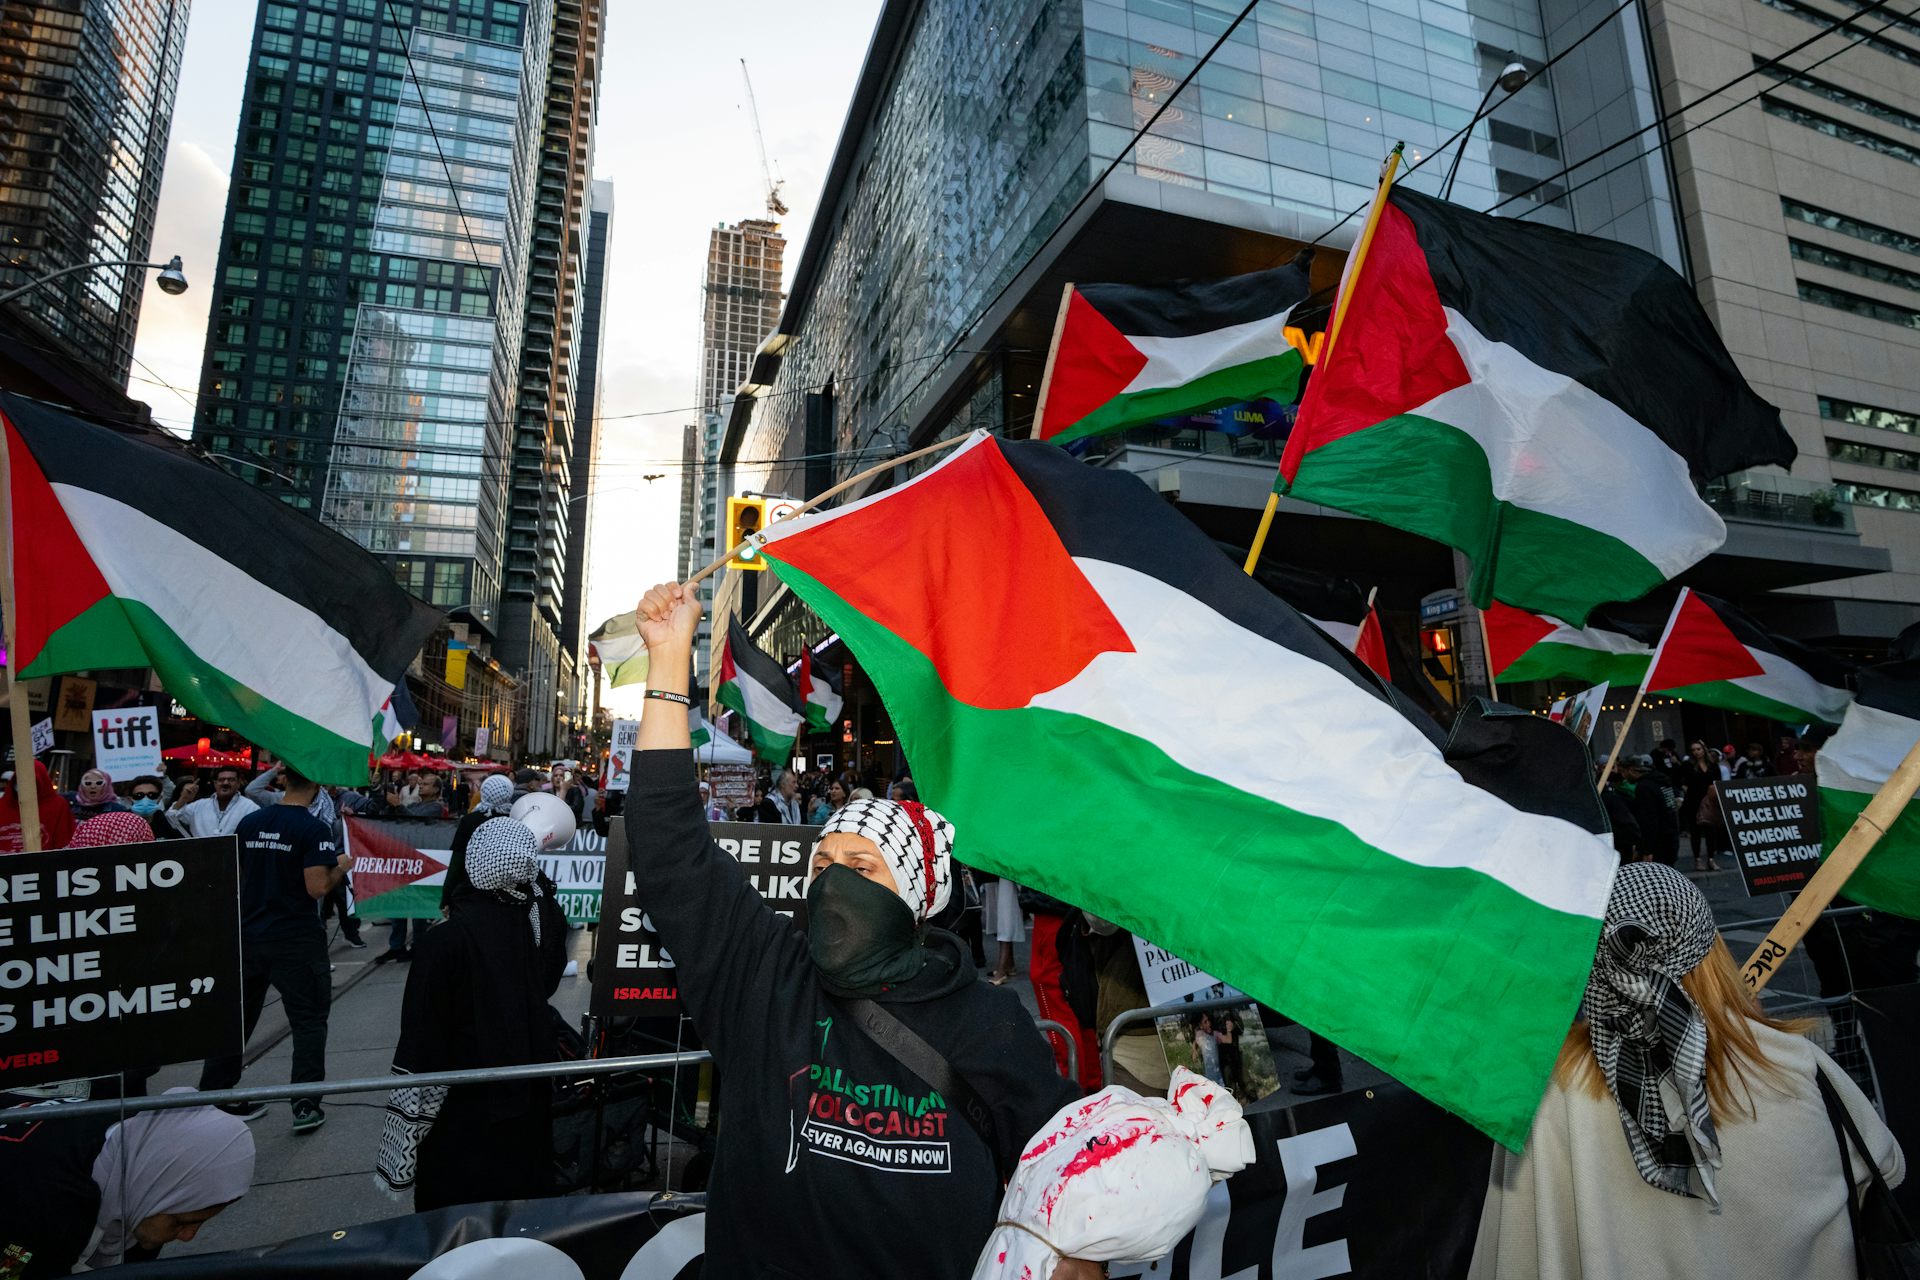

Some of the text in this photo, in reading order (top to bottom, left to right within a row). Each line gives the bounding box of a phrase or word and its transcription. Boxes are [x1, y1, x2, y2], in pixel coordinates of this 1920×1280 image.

[1775, 785, 1788, 800] IS
[1787, 783, 1807, 798] NO
[1731, 804, 1803, 825] PLACE LIKE
[1738, 825, 1801, 846] SOMEONE
[714, 838, 801, 865] RE IS
[56, 867, 101, 898] IS
[115, 860, 184, 892] NO
[750, 875, 808, 900] LIK
[30, 905, 137, 943] LIKE
[0, 950, 101, 989] ONE
[1145, 948, 1179, 968] PAL
[1162, 961, 1201, 984] CHIL
[614, 988, 677, 1000] ISRAELI
[844, 1139, 892, 1163] AGAIN
[894, 1150, 908, 1164] IS
[911, 1150, 945, 1165] NOW
